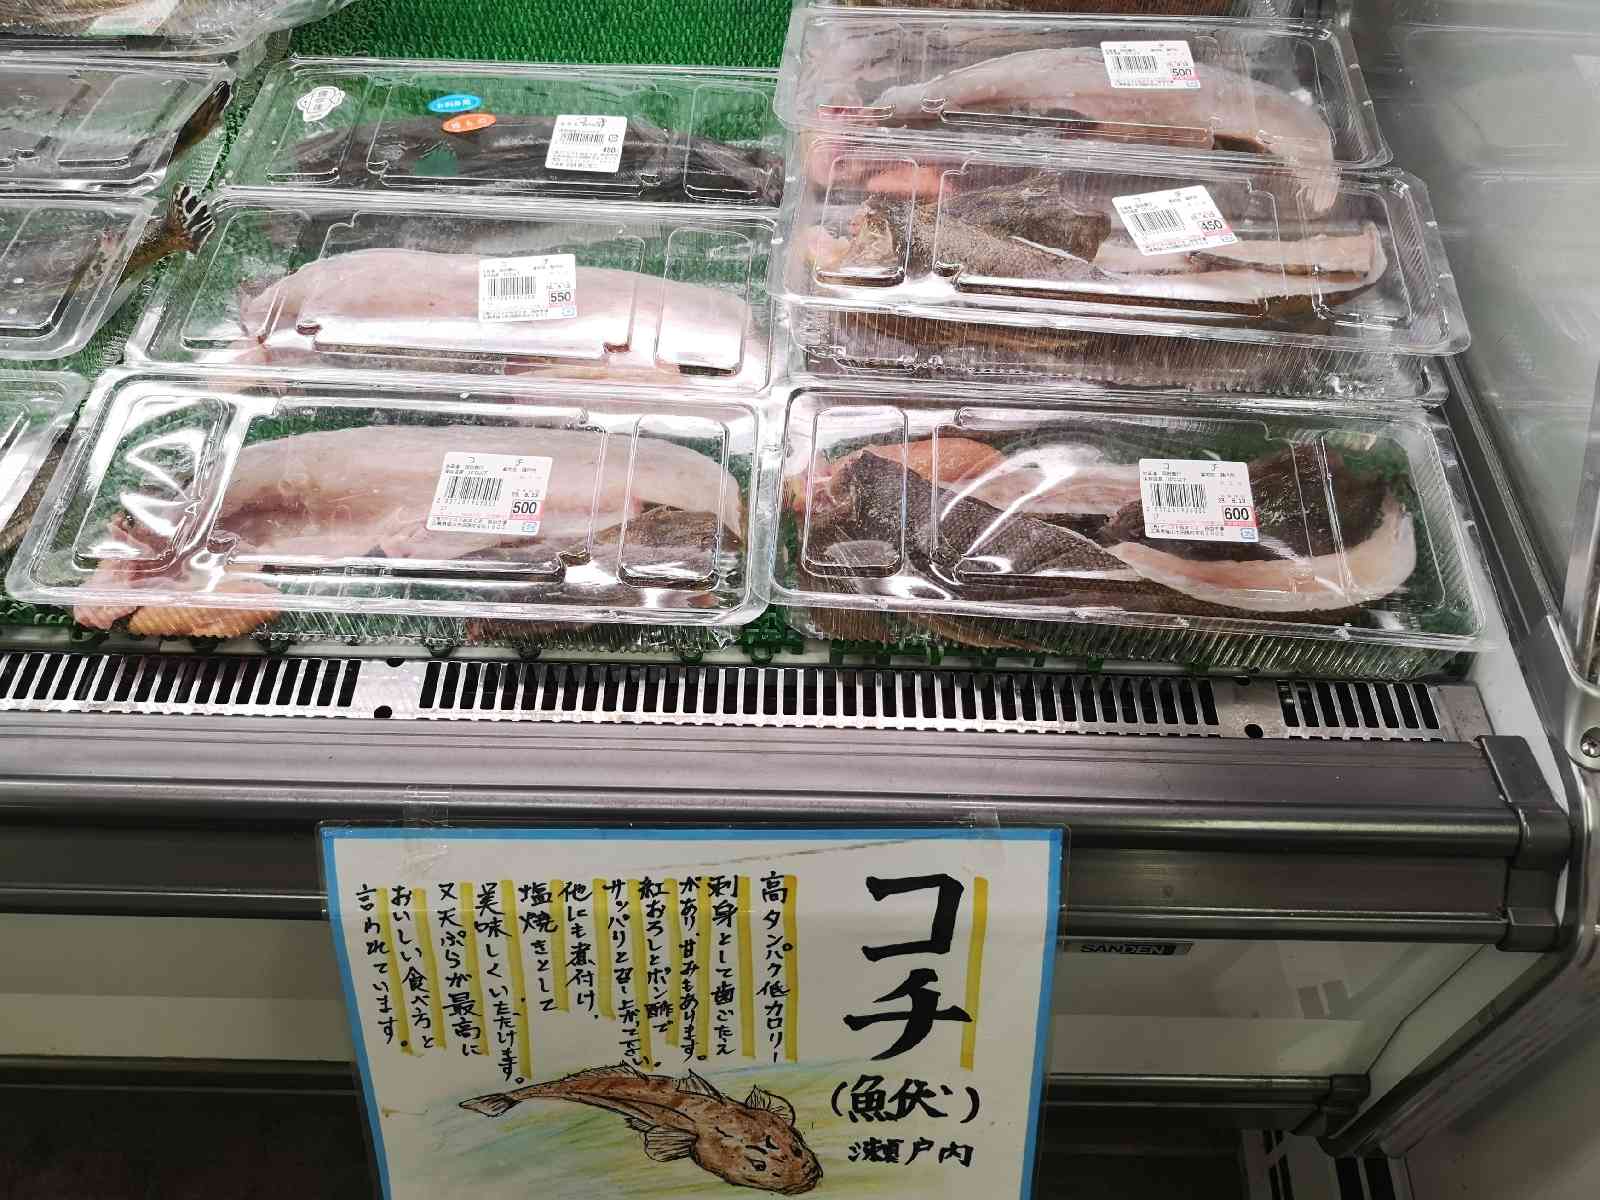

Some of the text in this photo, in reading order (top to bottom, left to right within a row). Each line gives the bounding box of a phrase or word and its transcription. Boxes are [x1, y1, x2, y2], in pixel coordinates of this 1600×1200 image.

[1171, 67, 1192, 78] 500
[1201, 219, 1223, 232] 450
[550, 291, 572, 303] 550
[512, 501, 537, 514] 500
[1224, 507, 1250, 521] 600
[391, 885, 435, 1049] おいしい食べ方と
[437, 882, 483, 1056] 又天ぷらが最高に
[518, 882, 558, 1011] 塩焼きとして
[707, 875, 738, 1056] 刺身として歯ごたえ
[756, 871, 793, 1063] 高タンパク低カロリー
[842, 873, 973, 1061] コチ
[848, 1137, 973, 1168] 瀬戸内
